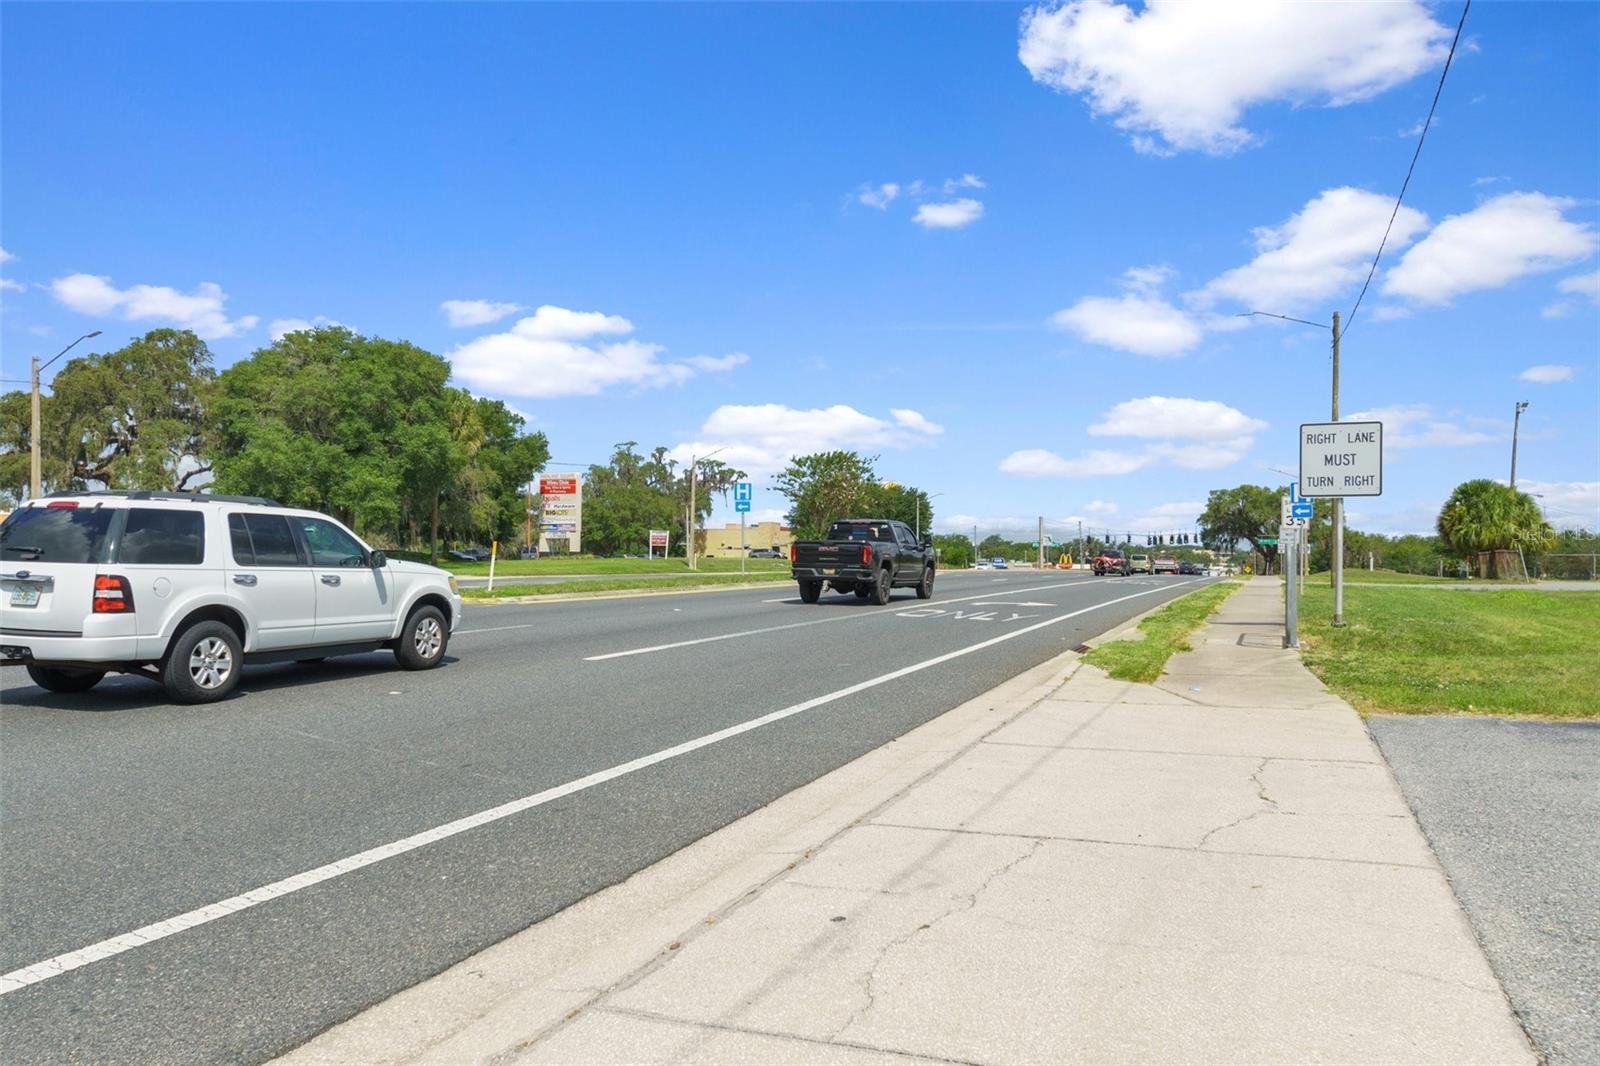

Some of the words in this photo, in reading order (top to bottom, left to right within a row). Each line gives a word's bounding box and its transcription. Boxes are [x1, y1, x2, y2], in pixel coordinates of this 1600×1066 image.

[1306, 433, 1337, 445] RIGHT
[1347, 431, 1376, 443] LANE
[1324, 453, 1357, 467] MUST
[1306, 476, 1334, 488] TURN
[1344, 474, 1375, 487] RIGHT
[737, 483, 750, 500] H
[1285, 515, 1306, 526] 35
